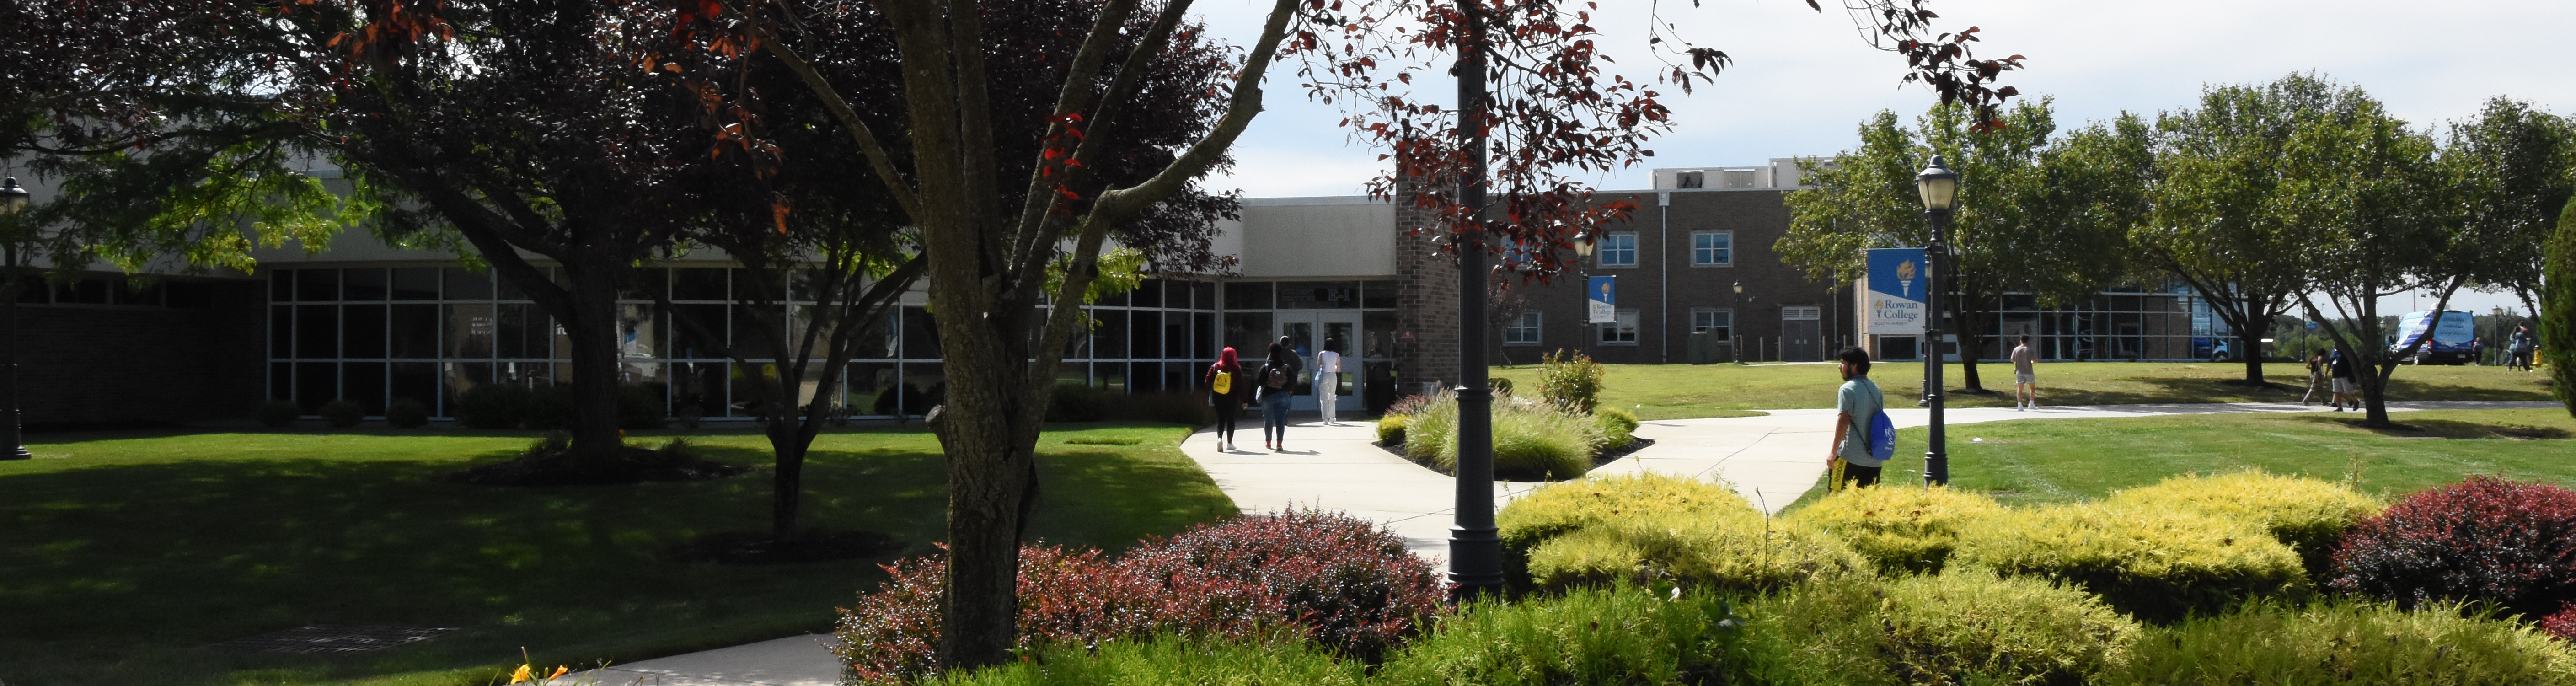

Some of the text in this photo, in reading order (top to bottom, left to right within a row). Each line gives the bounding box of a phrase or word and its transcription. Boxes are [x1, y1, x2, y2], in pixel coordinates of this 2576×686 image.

[1327, 289, 1350, 301] E-1
[1885, 300, 1918, 309] Rowan
[1884, 310, 1918, 322] College
